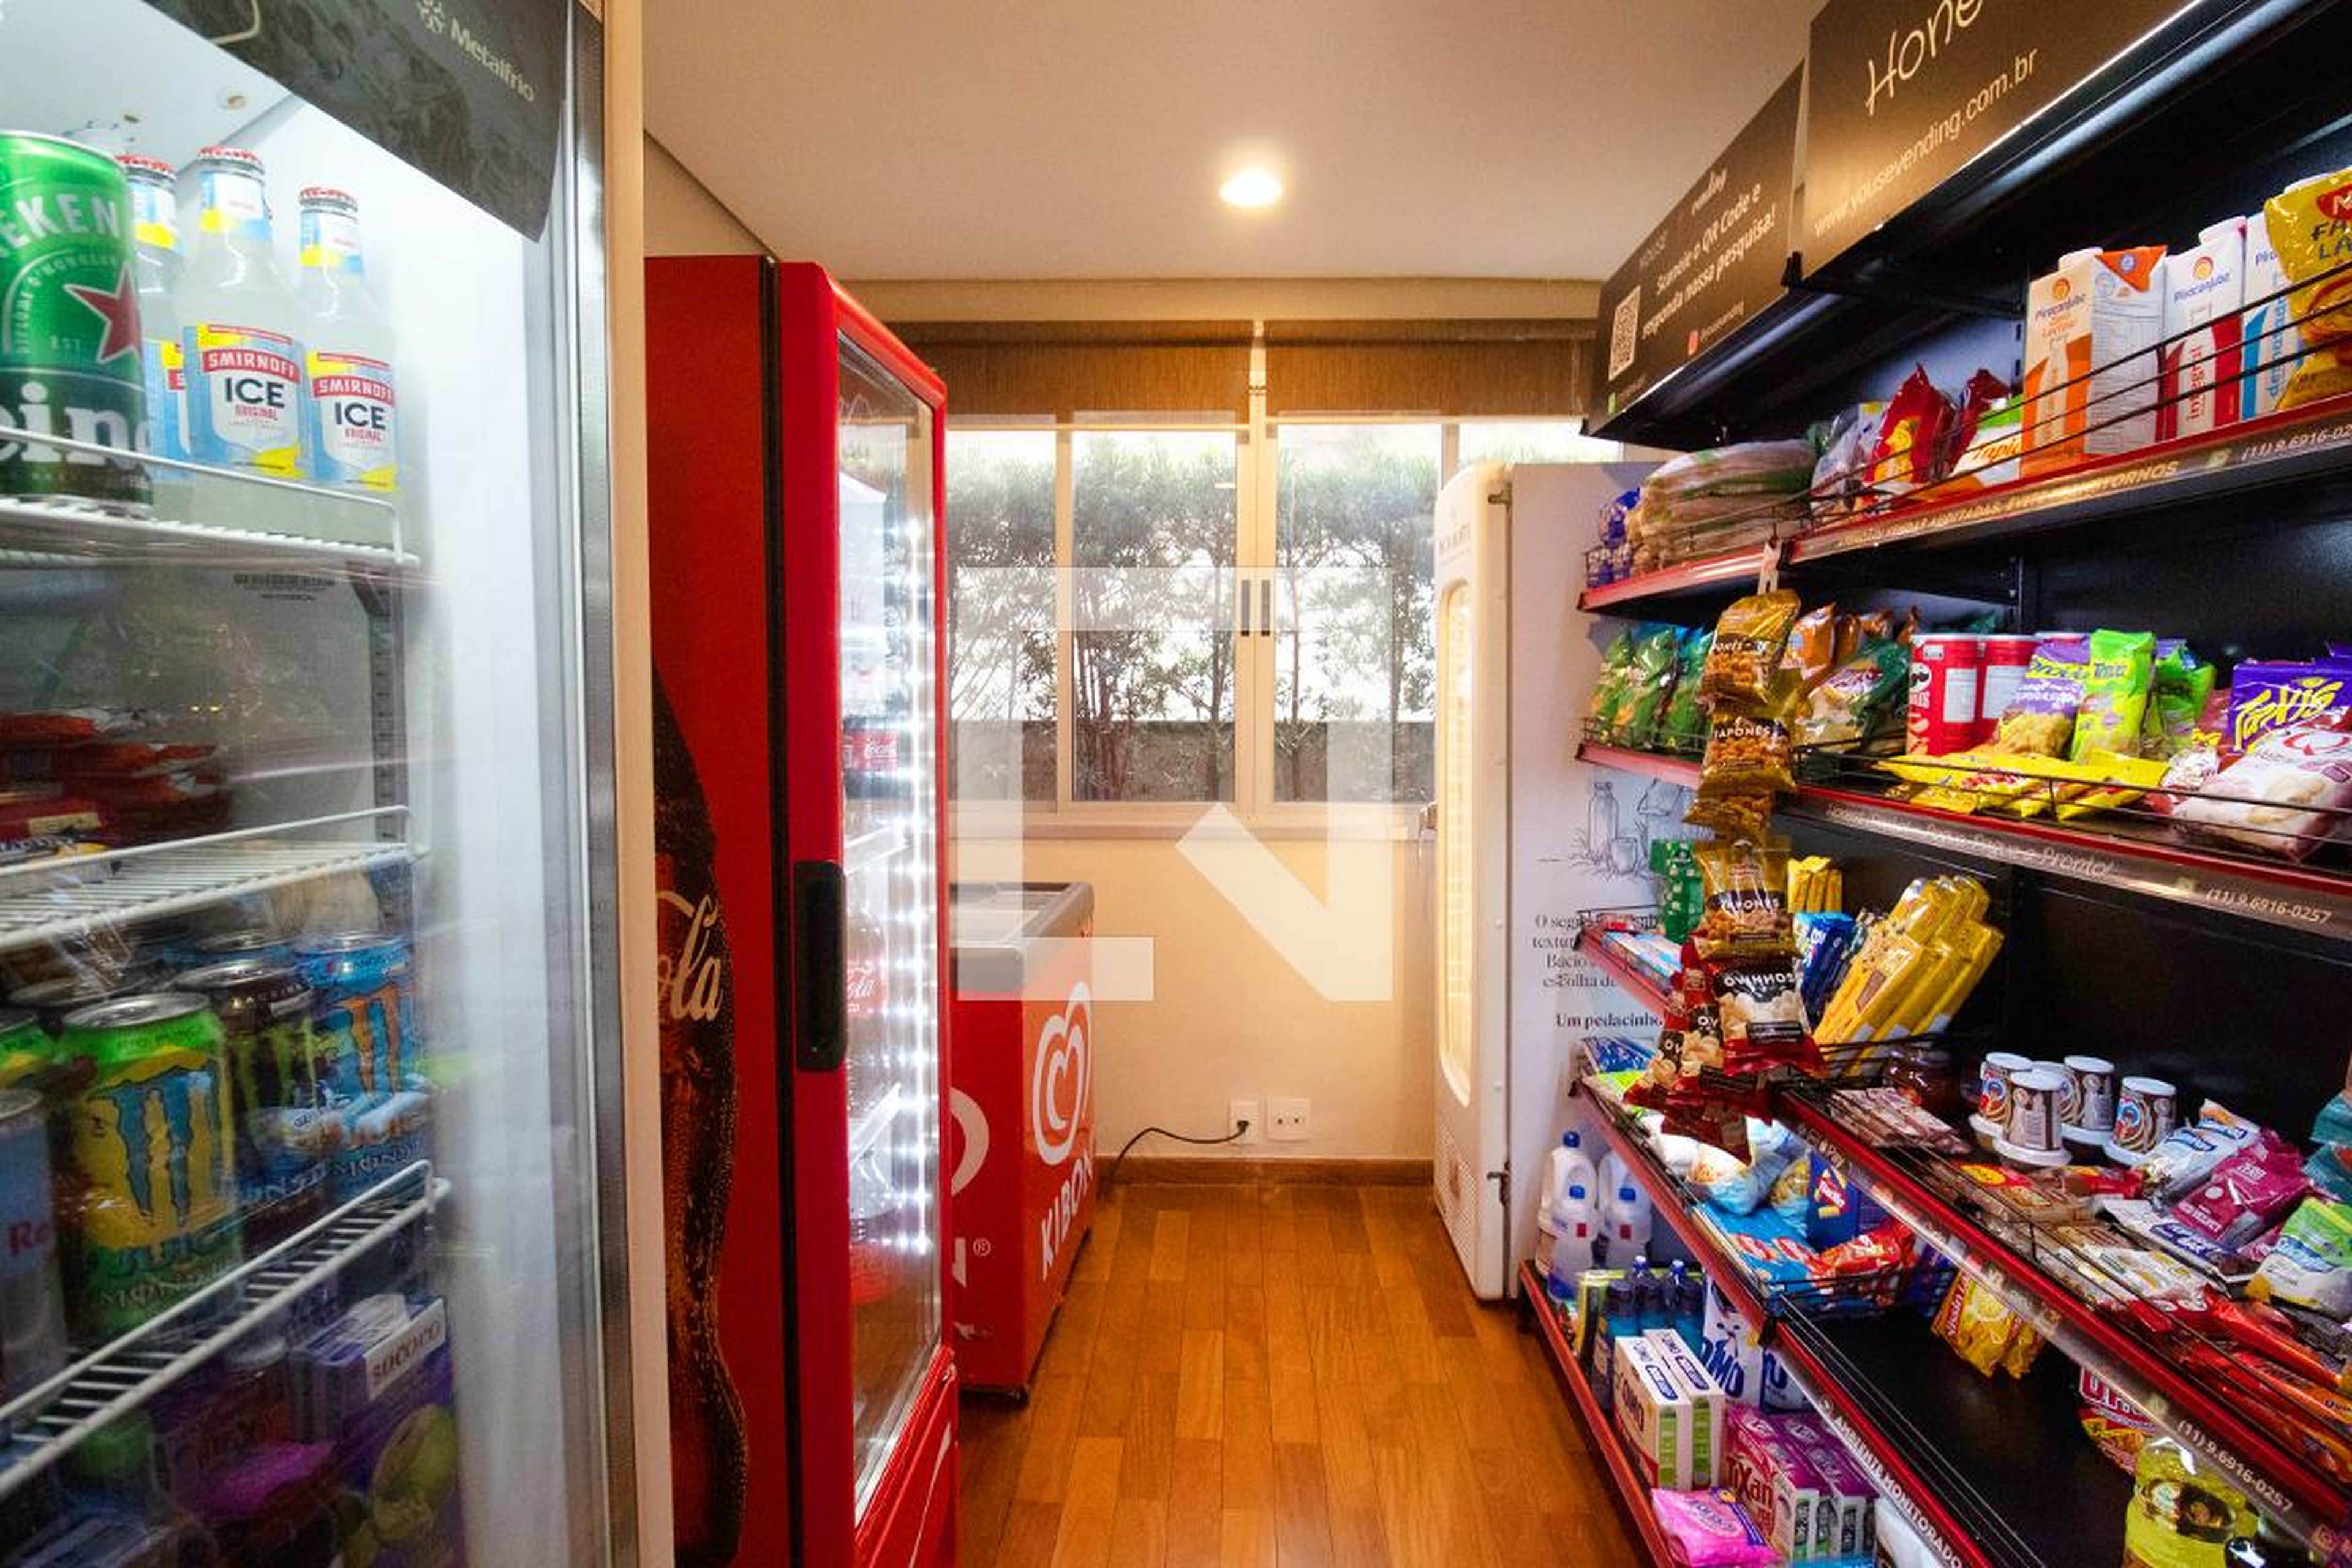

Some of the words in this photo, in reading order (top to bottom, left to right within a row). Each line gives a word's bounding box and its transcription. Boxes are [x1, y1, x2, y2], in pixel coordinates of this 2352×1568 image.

[208, 352, 296, 380] SMIRNOFF
[224, 377, 286, 409] ICE
[319, 378, 393, 405] SMIRNOFF
[334, 401, 386, 431] ICE
[1556, 1013, 1581, 1027] Um
[1042, 1147, 1094, 1283] KIBON
[2176, 1420, 2206, 1447] (11)
[2205, 1441, 2293, 1513] 9.6916-0257
[1881, 1473, 1963, 1568] MONITORADO
